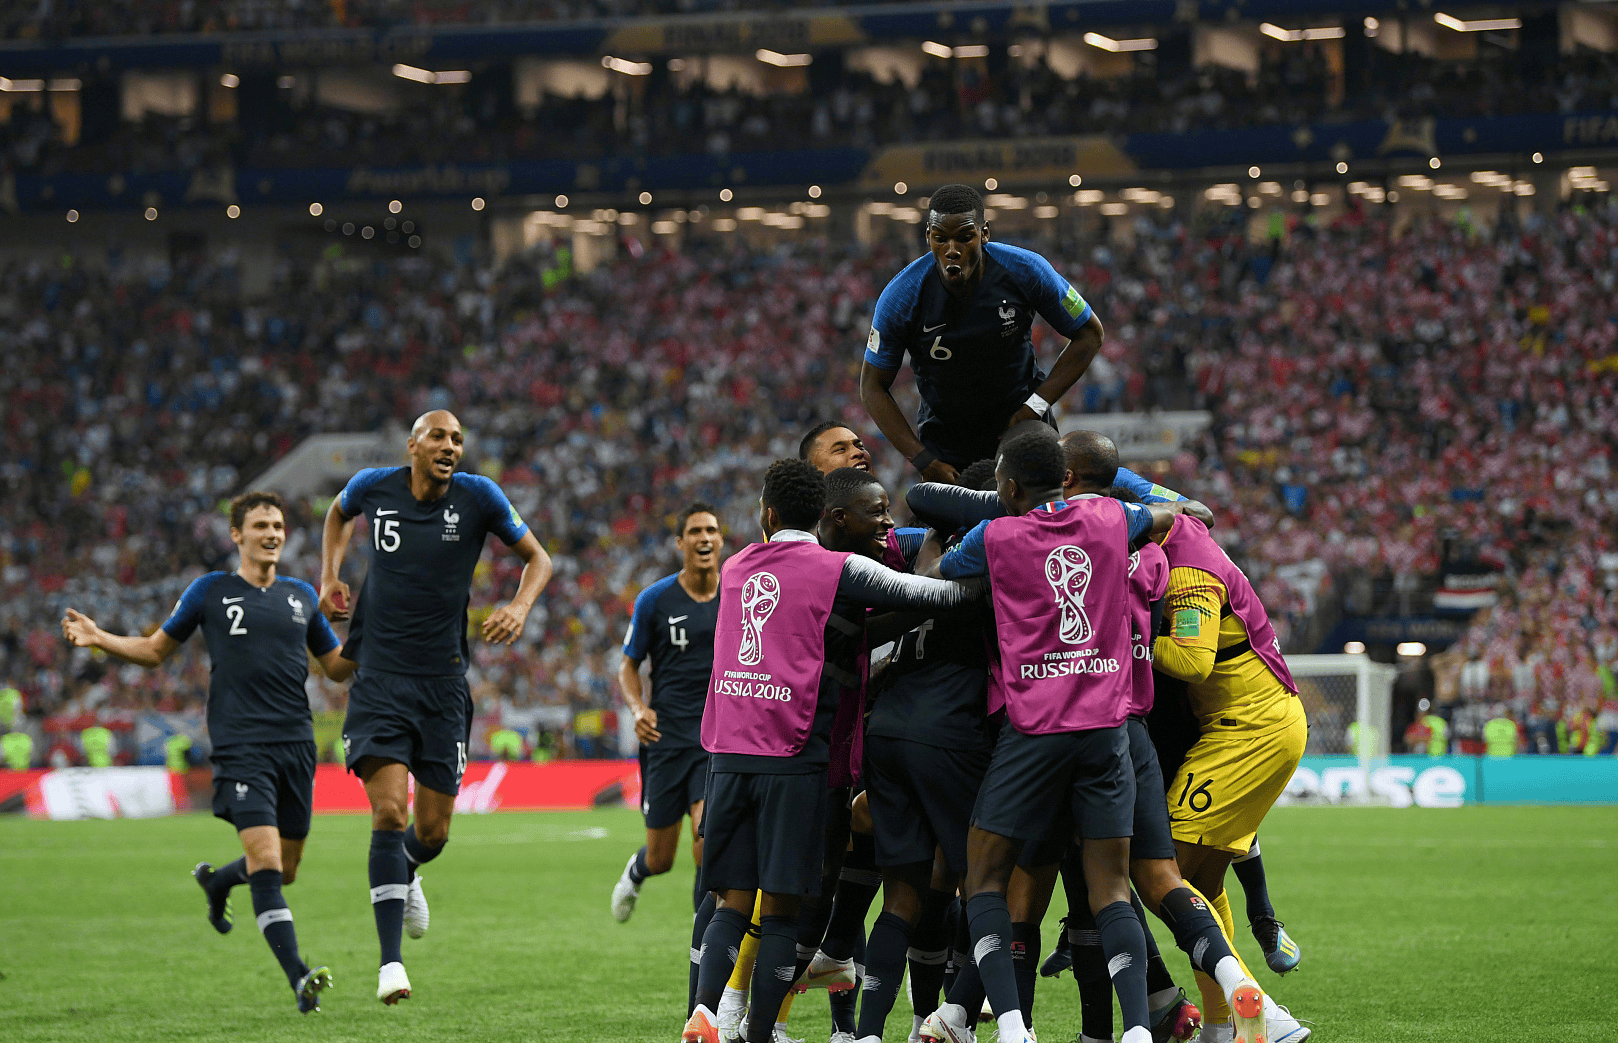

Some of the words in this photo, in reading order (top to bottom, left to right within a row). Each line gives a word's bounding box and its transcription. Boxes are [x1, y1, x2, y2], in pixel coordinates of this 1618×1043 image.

[930, 335, 952, 361] 6
[373, 517, 401, 553] 15
[226, 604, 248, 636] 2
[670, 625, 690, 652] 4
[1043, 652, 1062, 661] FIFA
[1062, 648, 1092, 660] WORLD
[724, 670, 737, 679] FIFA
[737, 671, 758, 680] WORLD
[758, 673, 772, 682] CUP
[1020, 658, 1088, 680] RUSSIA
[1086, 657, 1120, 675] 2018
[714, 679, 753, 697] USSIA
[753, 683, 792, 702] 2018
[1177, 772, 1214, 813] 16
